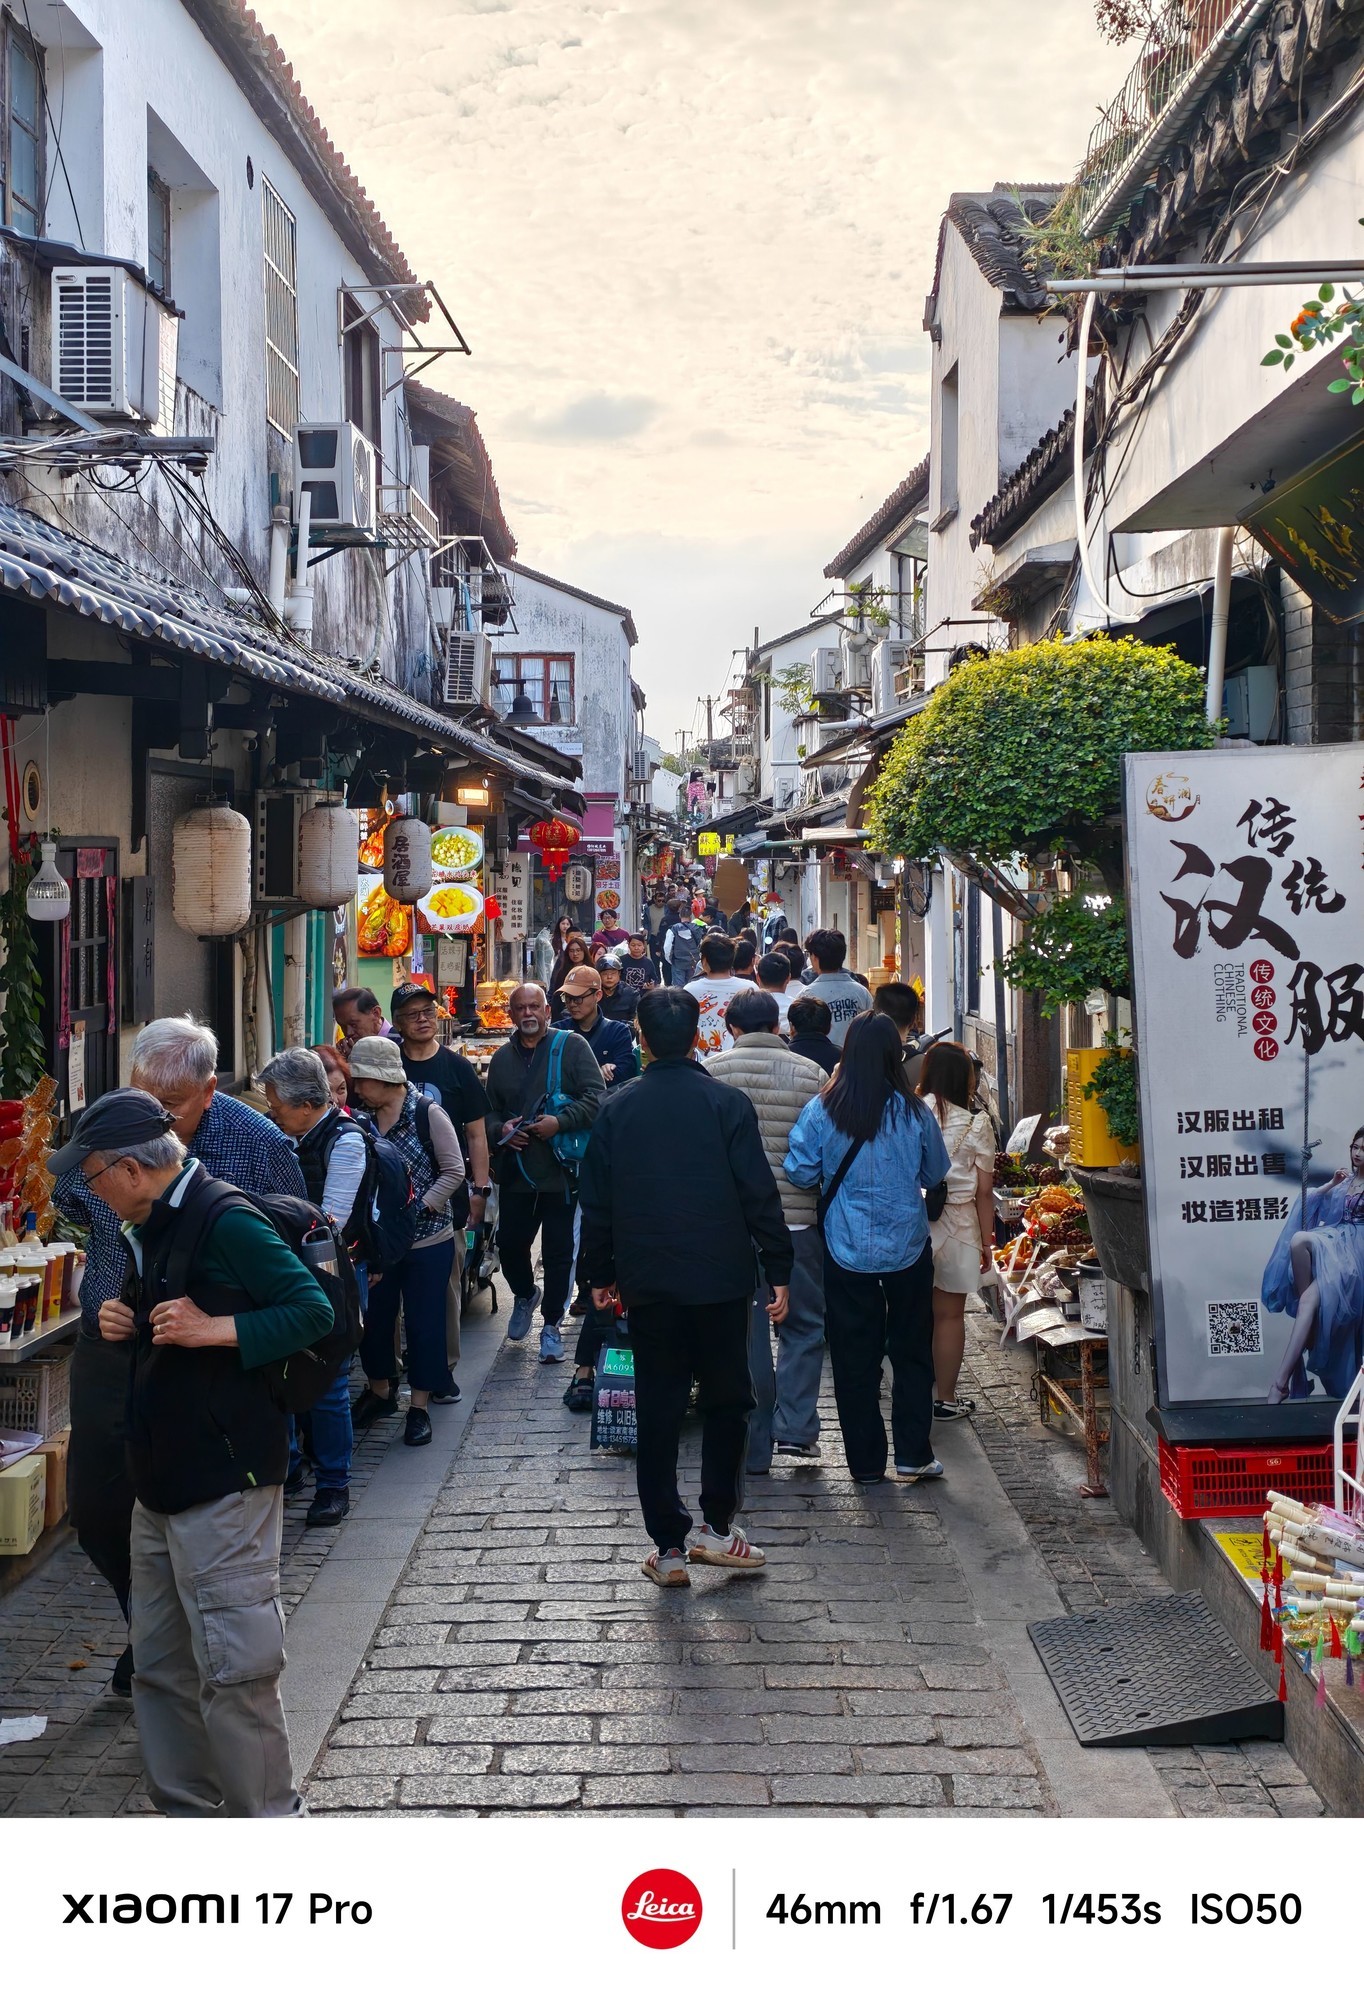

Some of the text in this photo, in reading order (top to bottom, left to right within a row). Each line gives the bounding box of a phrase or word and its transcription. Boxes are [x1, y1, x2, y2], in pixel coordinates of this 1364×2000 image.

[391, 835, 411, 887] 居酒屋
[1236, 797, 1347, 915] 传统
[431, 923, 470, 931] 芒果双皮奶
[1159, 840, 1364, 1055] 汉服
[1213, 963, 1226, 1023] CLOTHING
[1224, 963, 1236, 1013] CHINESE
[1235, 963, 1248, 1038] TRADITIONAL
[1251, 961, 1277, 1060] 传统文化
[1177, 1107, 1285, 1134] 汉服出租
[1180, 1152, 1286, 1179] 汉服出售
[1181, 1197, 1289, 1224] 妆造摄影
[597, 1410, 613, 1425] 维修
